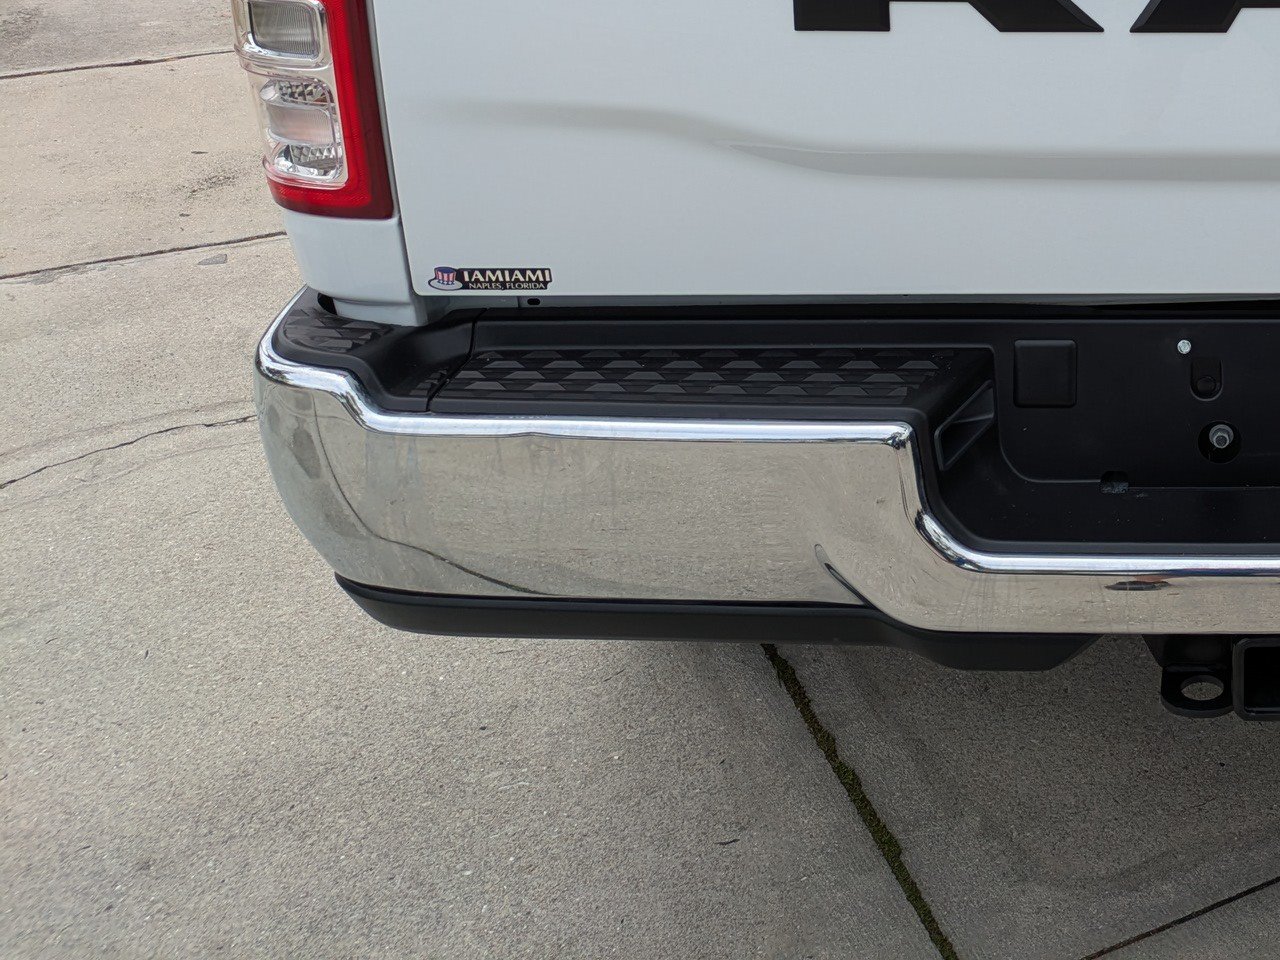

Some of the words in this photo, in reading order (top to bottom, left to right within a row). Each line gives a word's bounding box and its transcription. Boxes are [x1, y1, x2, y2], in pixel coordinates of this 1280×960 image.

[461, 269, 552, 282] TAMIAMI
[468, 282, 505, 290] NAPLES,
[505, 282, 546, 290] FLORIDA
